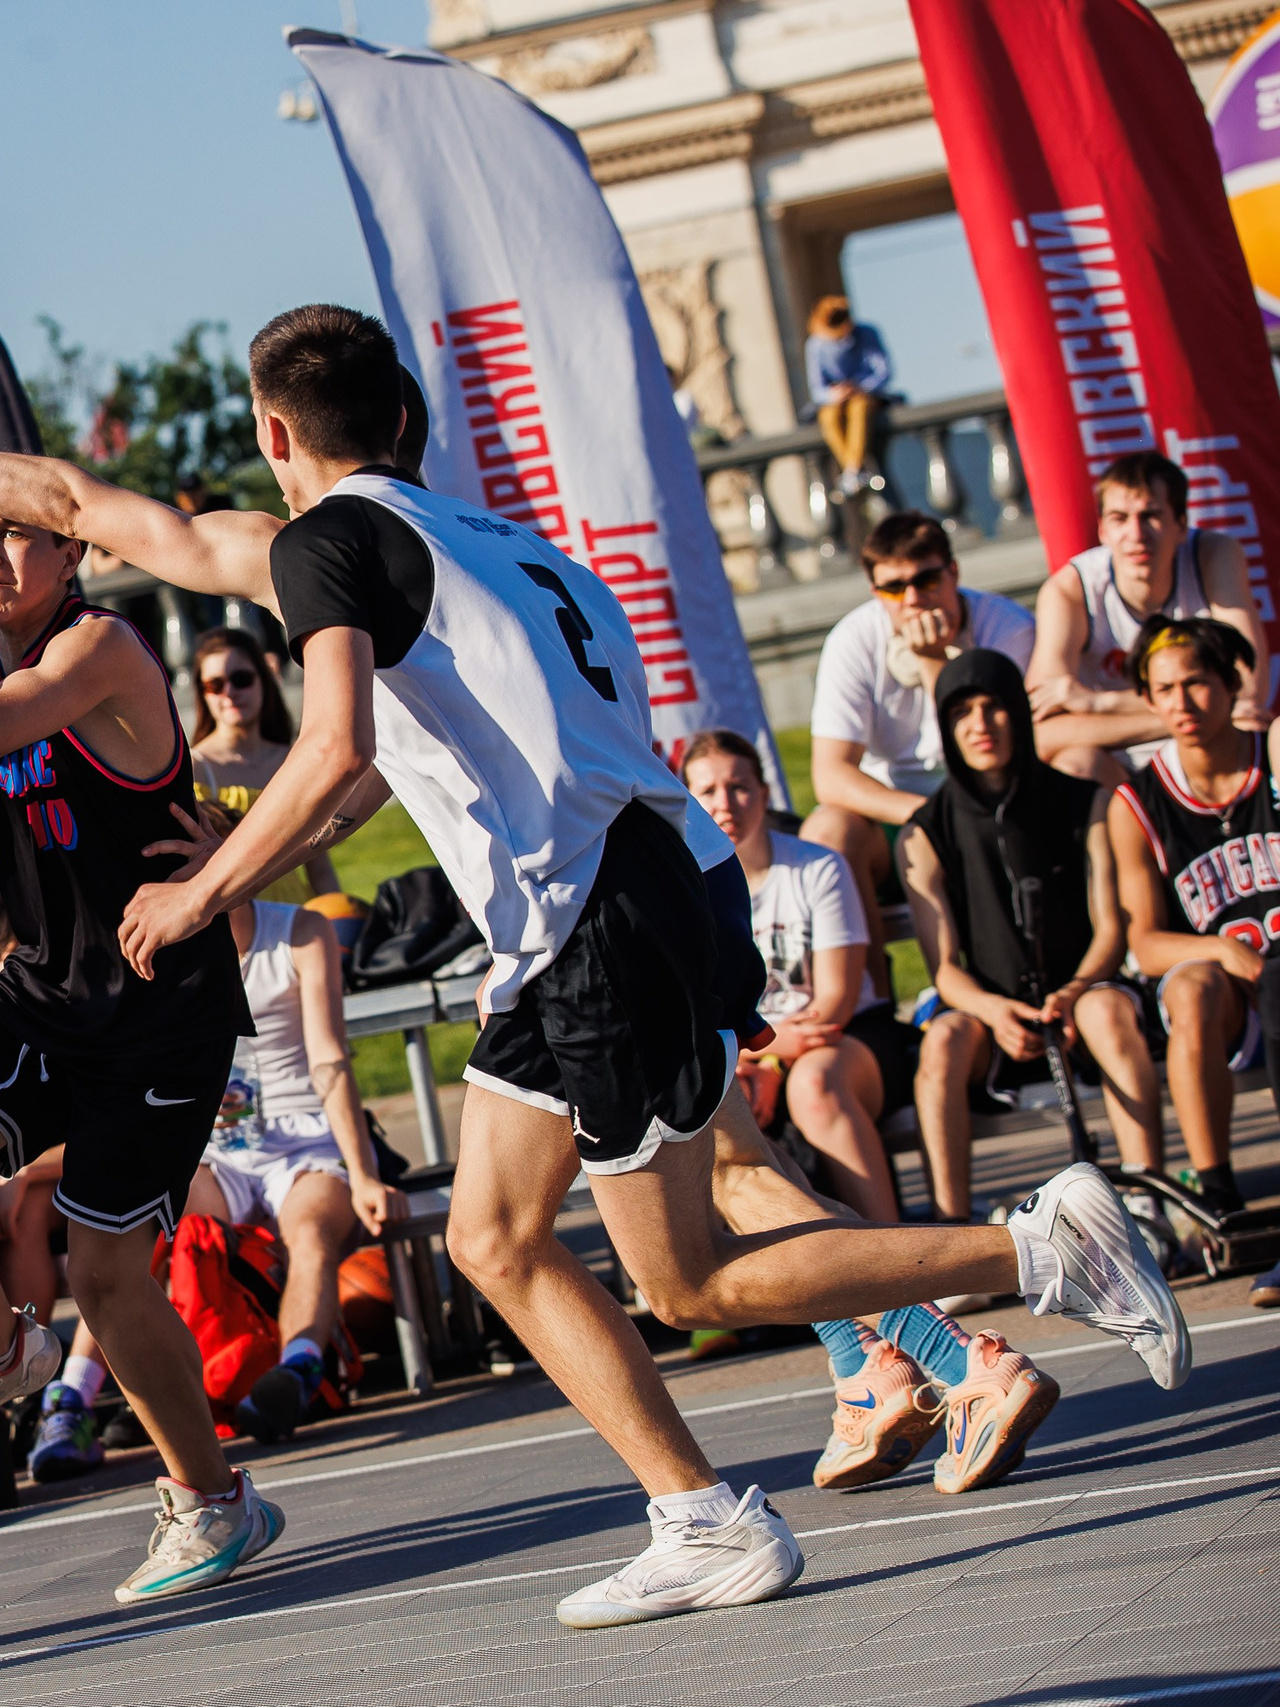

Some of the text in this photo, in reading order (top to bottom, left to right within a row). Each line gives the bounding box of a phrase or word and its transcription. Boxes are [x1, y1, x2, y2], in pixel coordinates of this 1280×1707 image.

[431, 299, 574, 555] ОВСКИЙ
[1012, 203, 1157, 476] ОВСКИЙ
[515, 560, 619, 703] 2
[26, 798, 79, 852] 10
